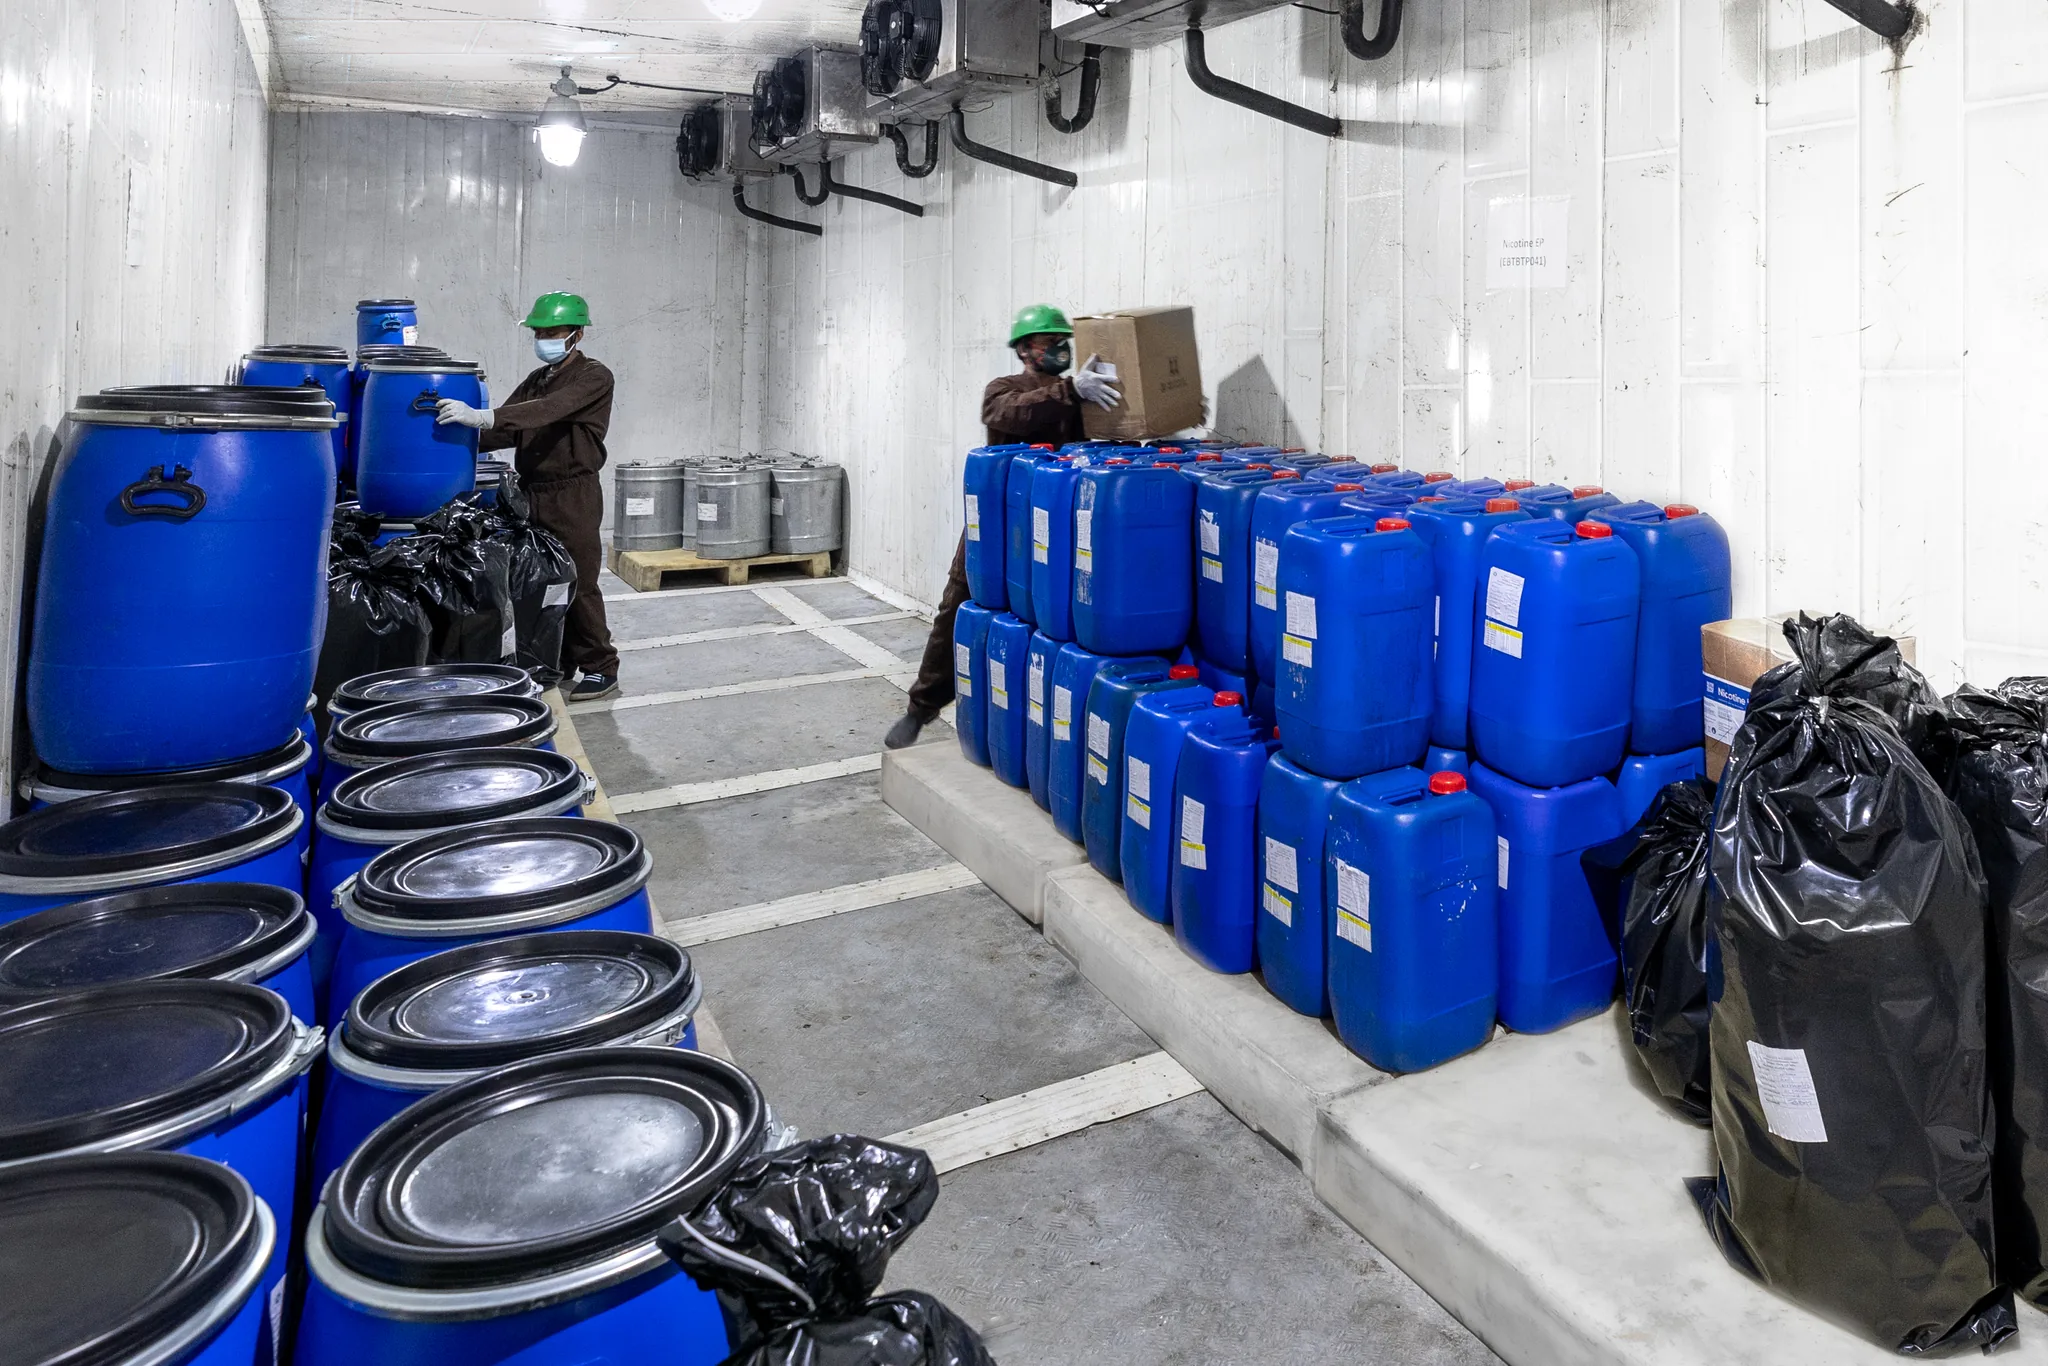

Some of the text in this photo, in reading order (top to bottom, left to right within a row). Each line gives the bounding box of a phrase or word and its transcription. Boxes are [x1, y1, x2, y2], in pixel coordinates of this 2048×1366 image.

[1503, 238, 1544, 248] Nicotine EP
[1718, 687, 1746, 705] Nicotine
